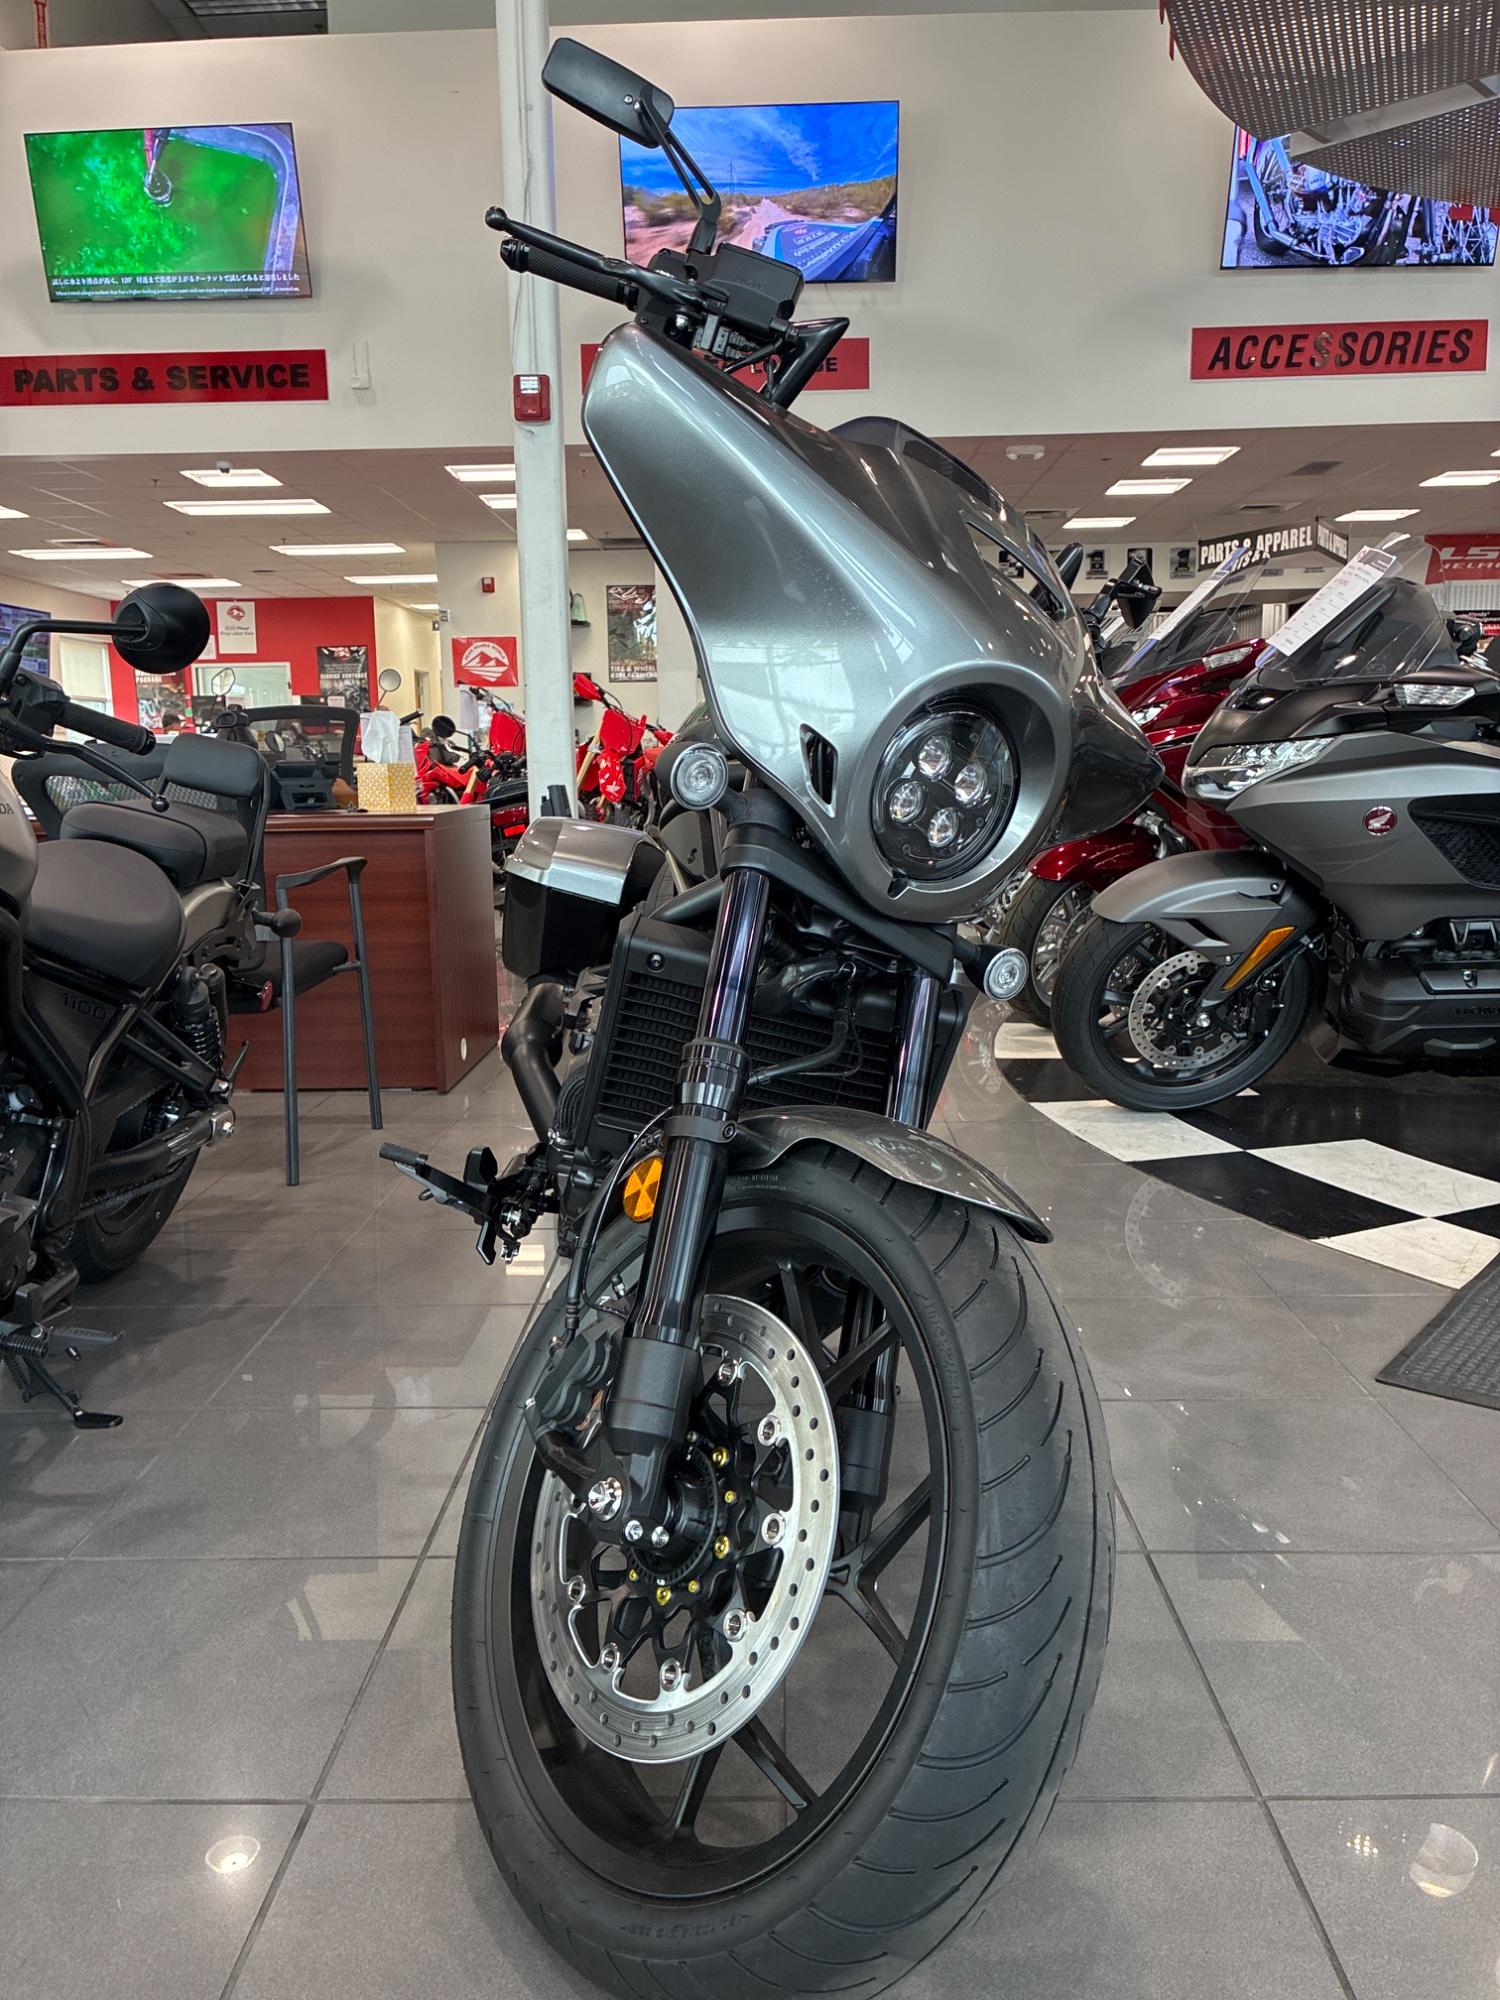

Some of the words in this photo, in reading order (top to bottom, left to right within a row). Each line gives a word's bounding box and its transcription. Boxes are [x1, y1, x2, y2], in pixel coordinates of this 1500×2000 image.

[1208, 328, 1474, 371] ACCESSORIES
[14, 366, 119, 393] PARTS
[131, 366, 155, 391] &
[166, 363, 310, 391] SERVICE
[1201, 539, 1240, 565] PARTS
[1256, 525, 1313, 554] APPAREL
